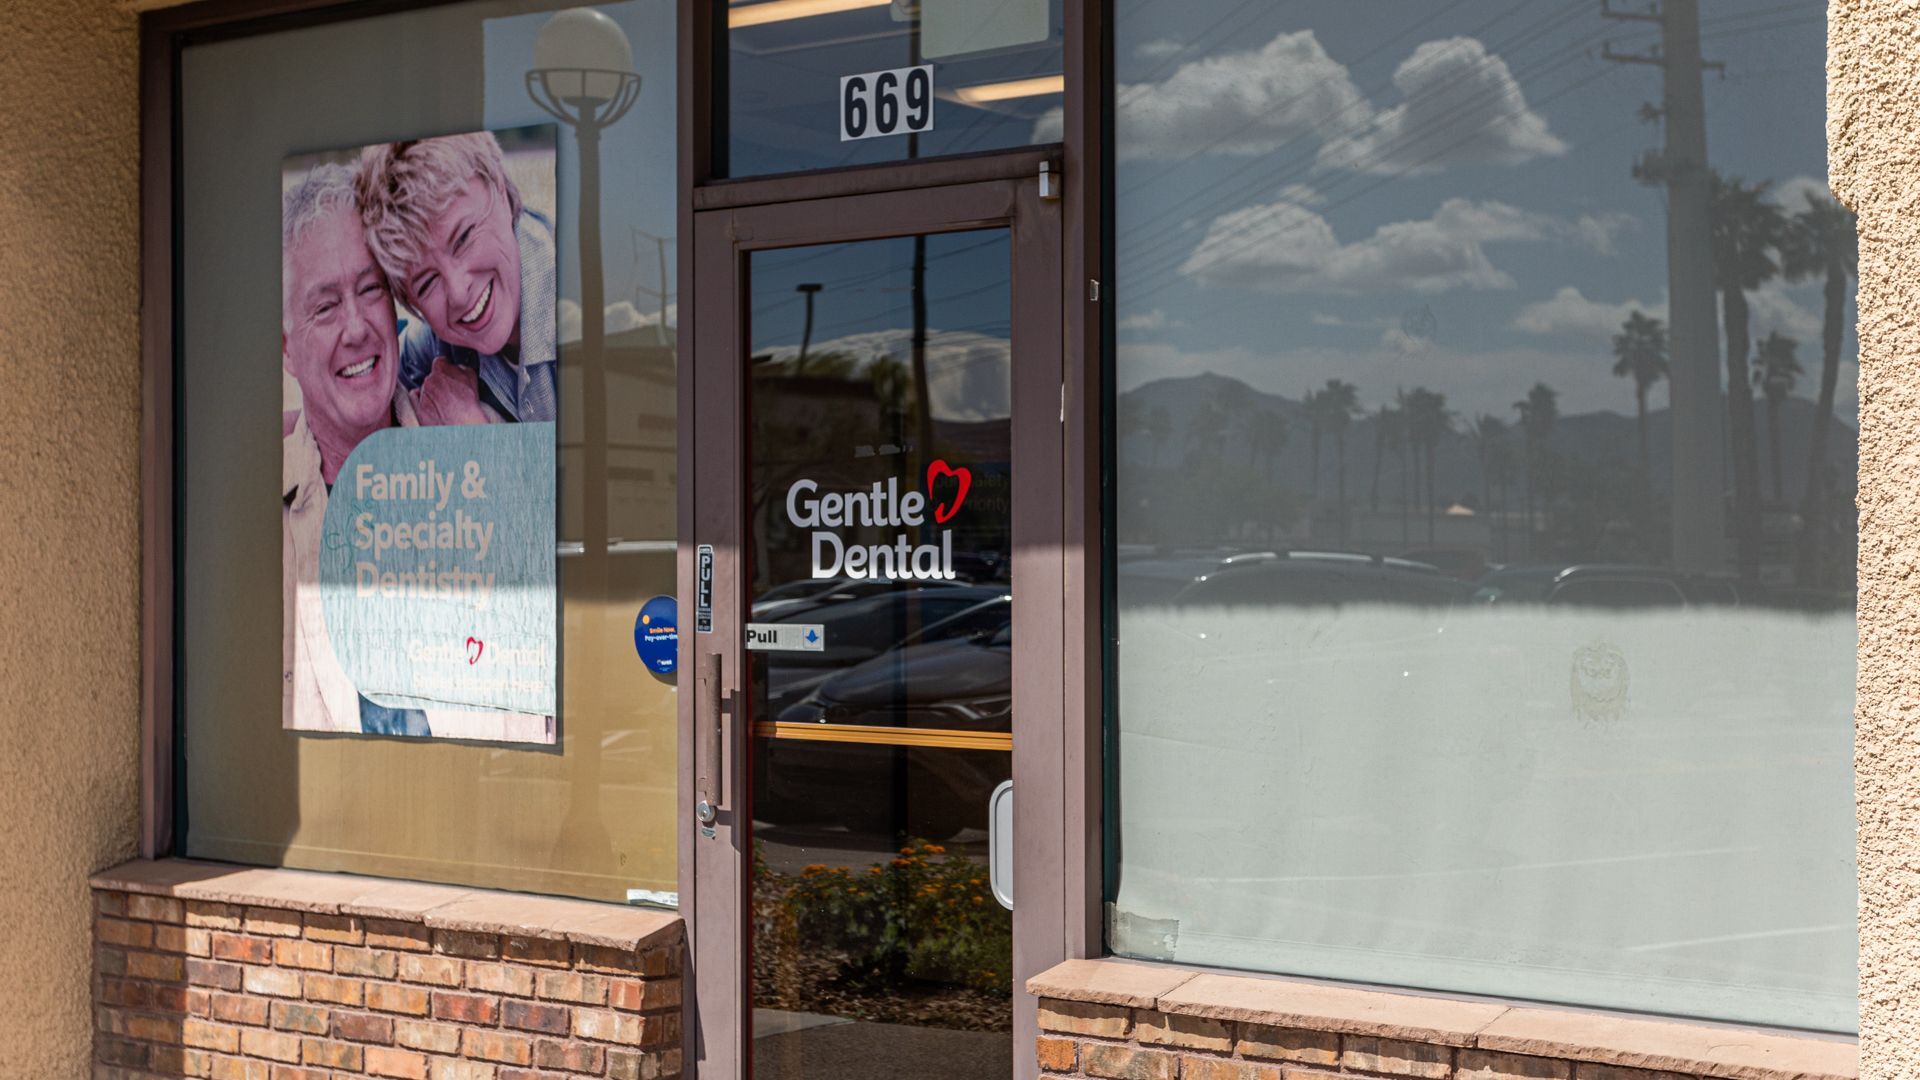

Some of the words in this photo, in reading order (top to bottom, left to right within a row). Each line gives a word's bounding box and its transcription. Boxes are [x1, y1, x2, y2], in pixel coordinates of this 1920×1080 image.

[844, 68, 930, 138] 669
[356, 460, 455, 511] Family
[461, 460, 487, 498] &
[786, 477, 925, 527] Gentle
[355, 509, 494, 561] Specialty
[812, 529, 956, 580] Dental
[356, 561, 495, 611] Dentistry
[700, 555, 711, 607] PULL
[746, 630, 778, 643] Pull
